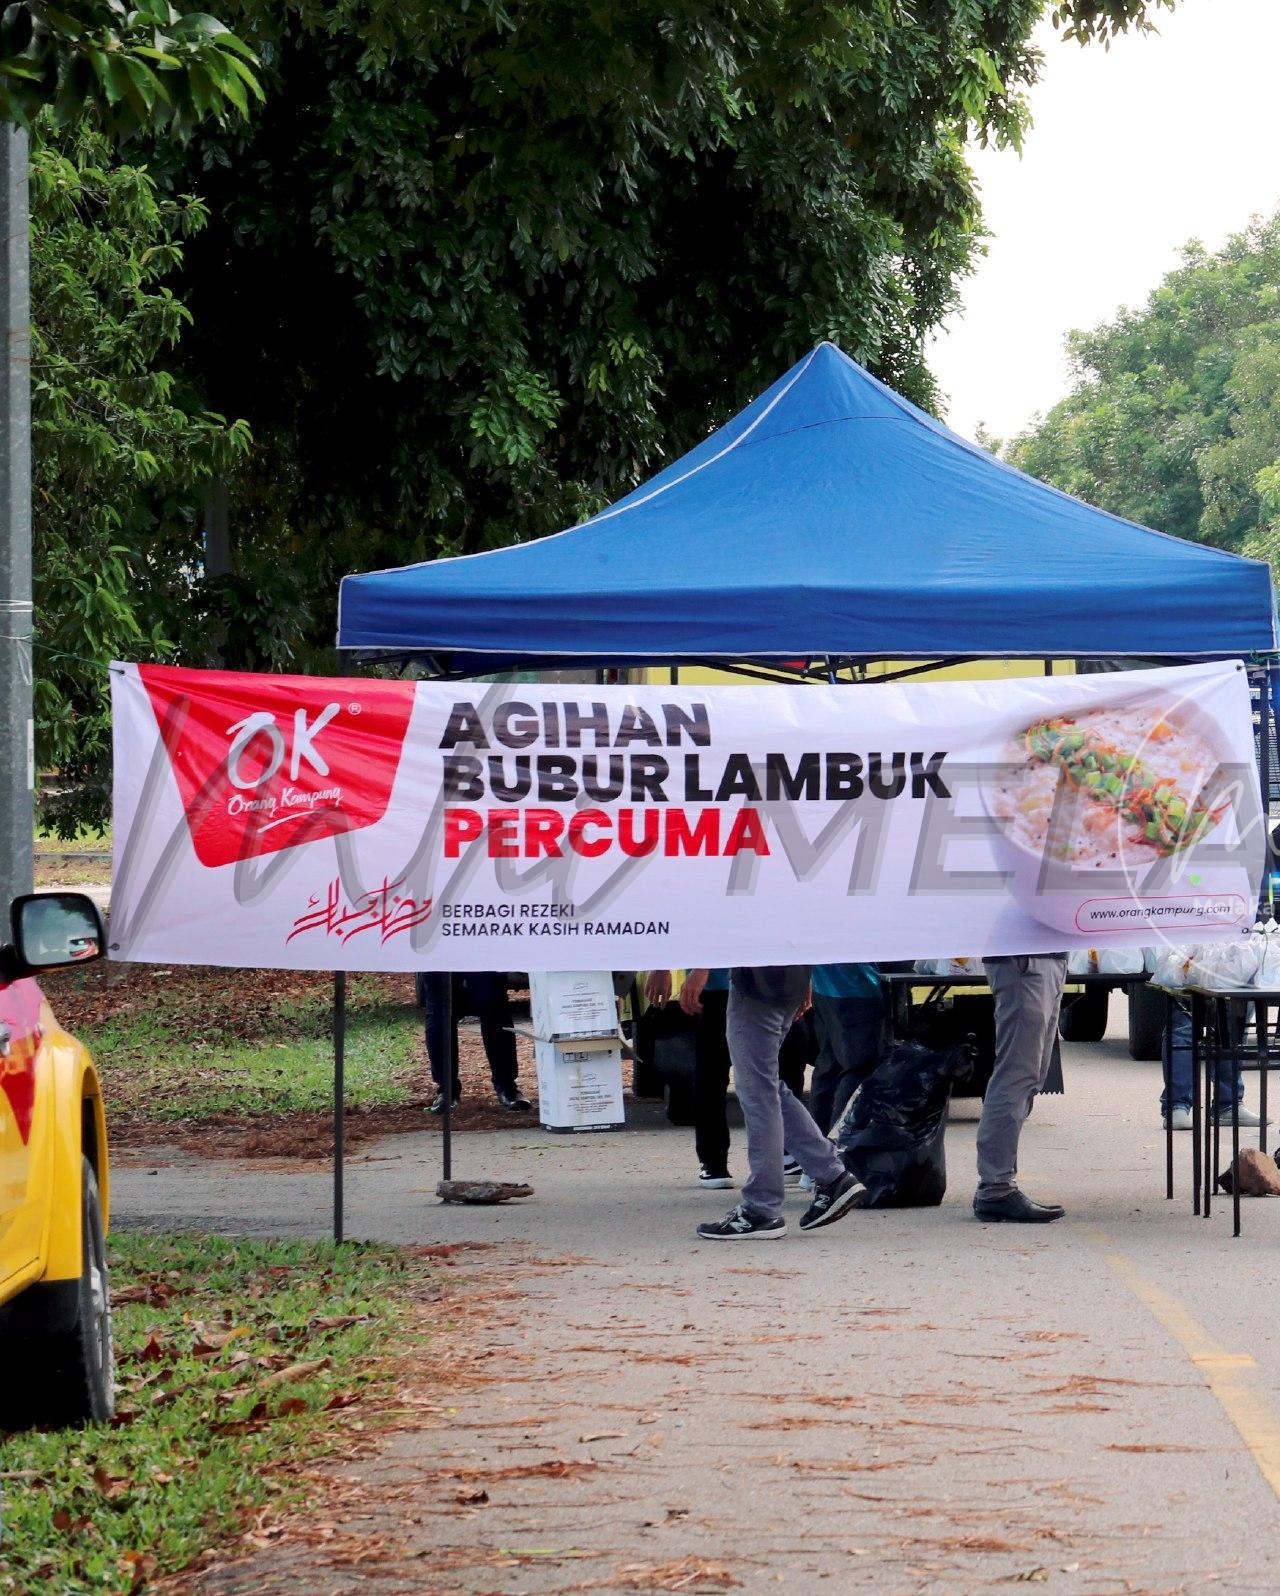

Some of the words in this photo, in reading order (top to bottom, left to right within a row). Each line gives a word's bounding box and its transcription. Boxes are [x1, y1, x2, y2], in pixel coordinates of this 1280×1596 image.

[226, 702, 341, 790] OK
[438, 701, 711, 749] AGIHAN
[442, 754, 670, 803] BUBUR
[684, 751, 952, 801] LAMBUK
[227, 794, 279, 818] Orang
[280, 787, 343, 810] Kampung
[443, 807, 771, 858] PERCUMA
[442, 904, 515, 918] BERBAGI
[520, 904, 575, 918] REZEKI
[442, 922, 524, 937] SEMARAK
[528, 922, 579, 937] KASIH
[584, 921, 670, 936] RAMADAN
